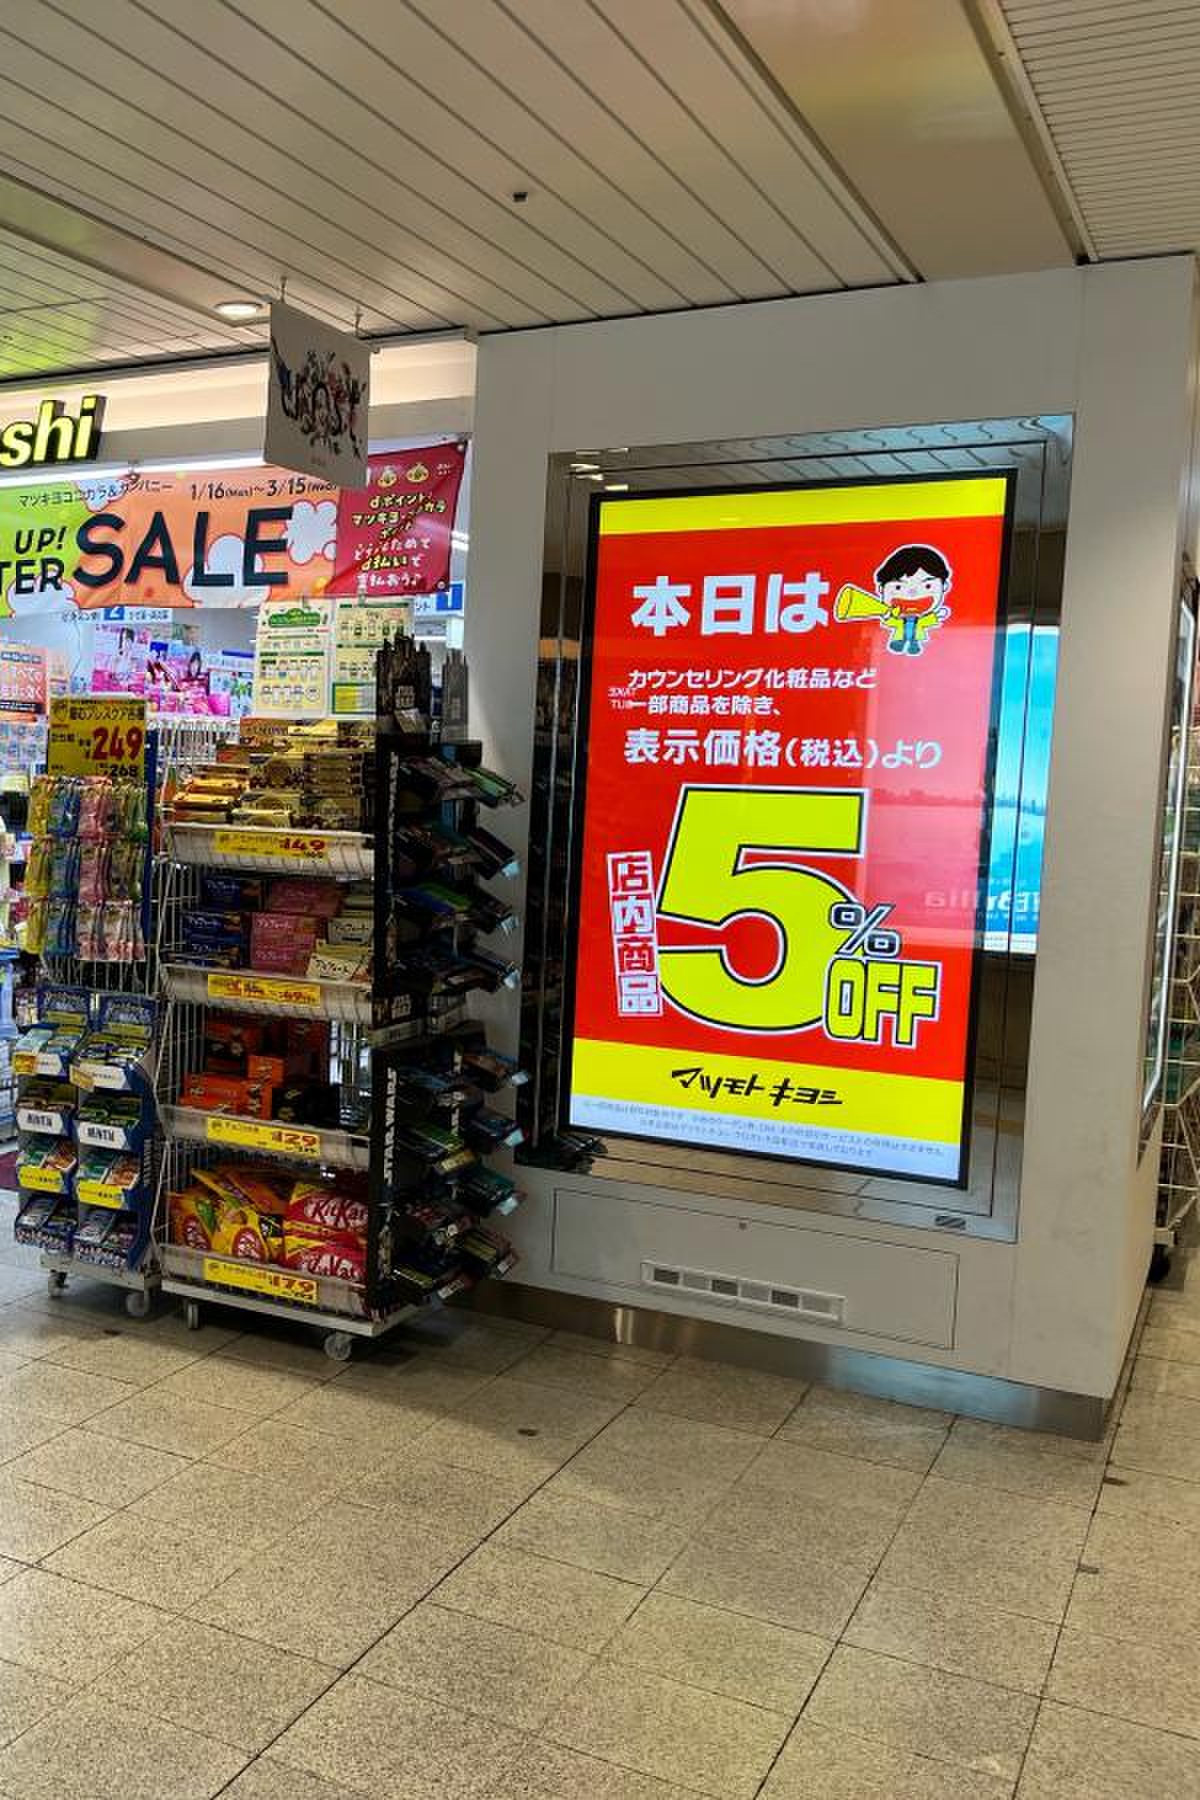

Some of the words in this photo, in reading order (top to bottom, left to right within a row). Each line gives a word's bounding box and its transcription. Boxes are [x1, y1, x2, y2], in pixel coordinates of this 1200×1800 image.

[15, 525, 67, 554] UP!
[73, 505, 294, 588] SALE
[632, 572, 830, 637] 本日は
[628, 667, 878, 689] カウンセリング化粧品など
[92, 725, 142, 761] 249
[607, 851, 662, 1016] 店内商品
[671, 1067, 843, 1106] マツモトキヨシ
